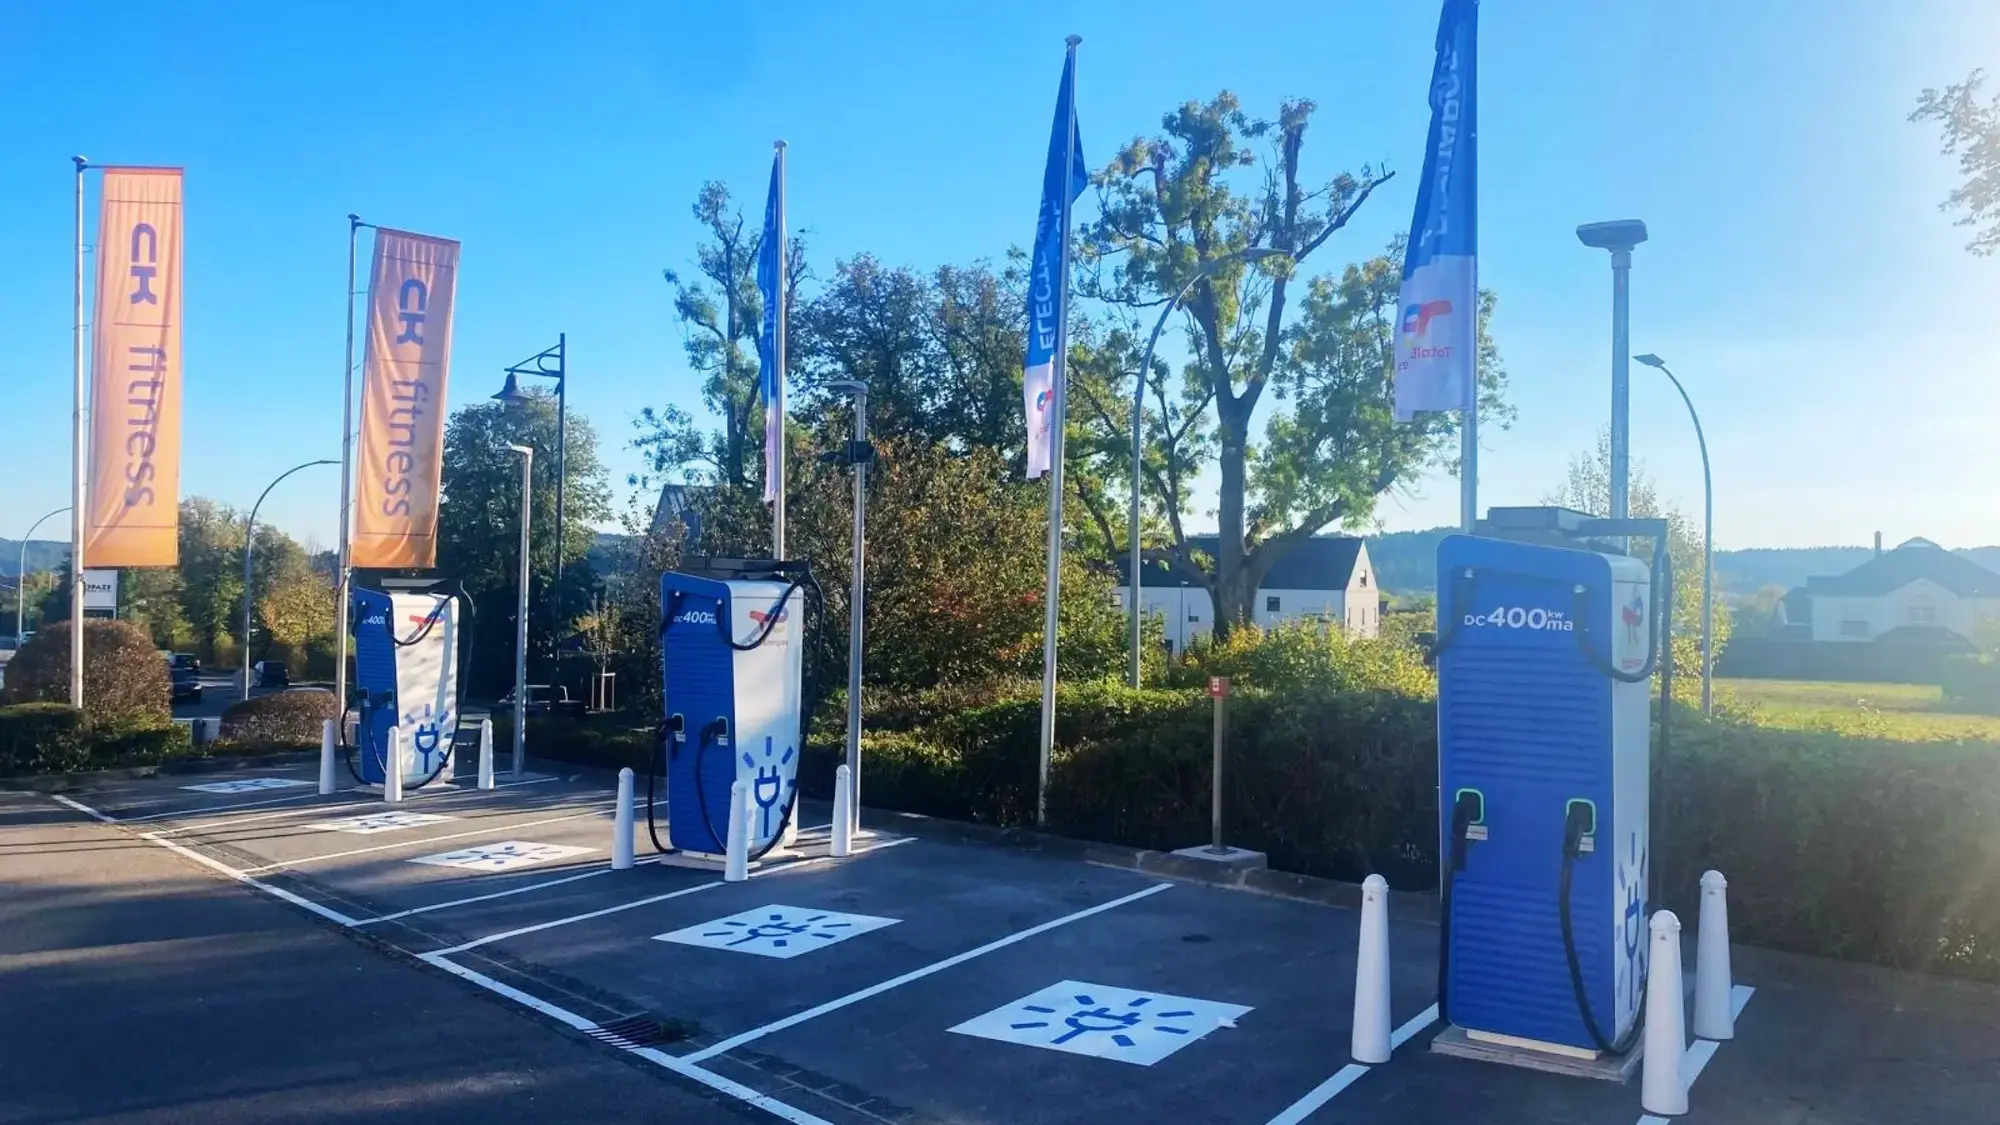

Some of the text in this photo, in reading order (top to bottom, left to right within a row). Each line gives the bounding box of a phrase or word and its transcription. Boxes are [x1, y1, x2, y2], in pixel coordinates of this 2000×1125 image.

[125, 343, 167, 506] fitness
[383, 378, 428, 516] fitness
[683, 610, 707, 623] 400
[1464, 615, 1486, 626] DC
[1487, 606, 1547, 629] 400
